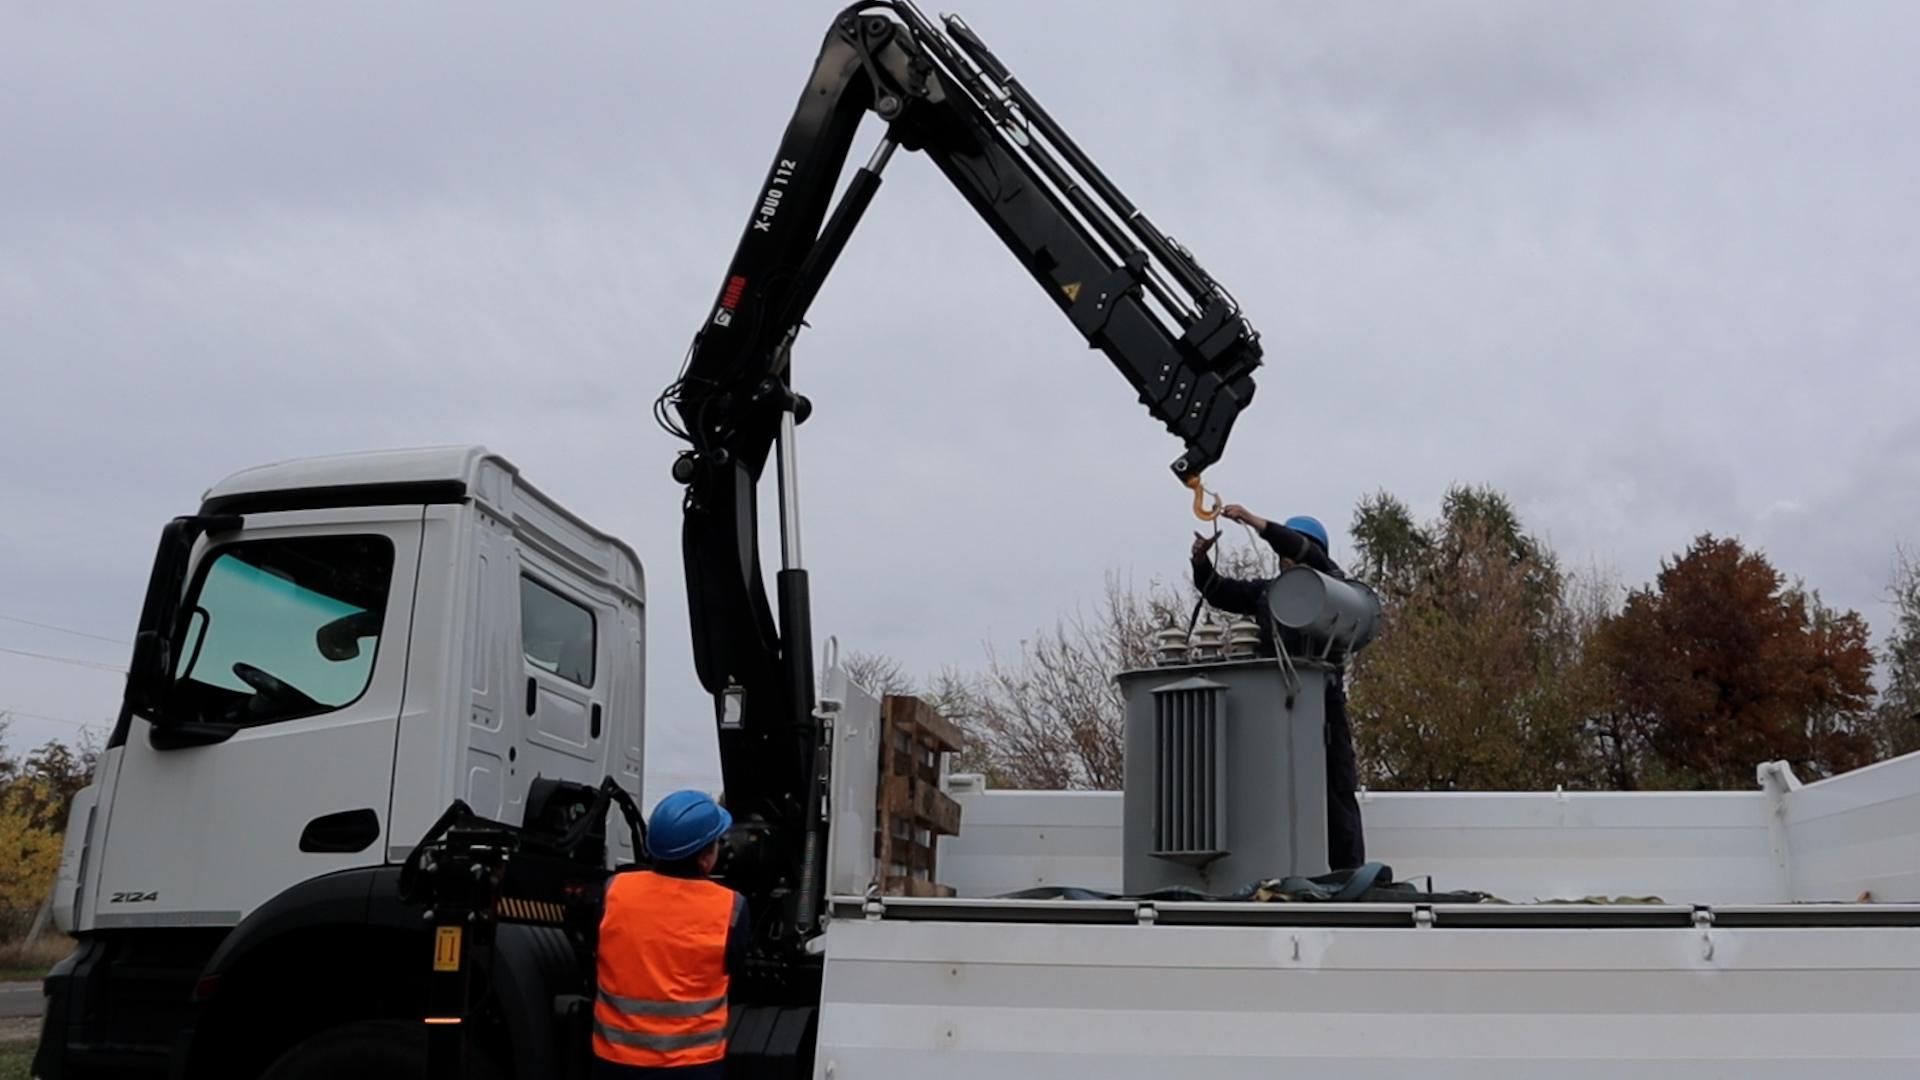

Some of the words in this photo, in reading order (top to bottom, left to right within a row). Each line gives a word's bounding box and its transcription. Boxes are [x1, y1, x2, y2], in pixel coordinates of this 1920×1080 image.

[754, 189, 783, 232] X-DUO
[773, 159, 797, 185] 112
[721, 275, 746, 309] HIAB
[110, 890, 159, 904] 2124
